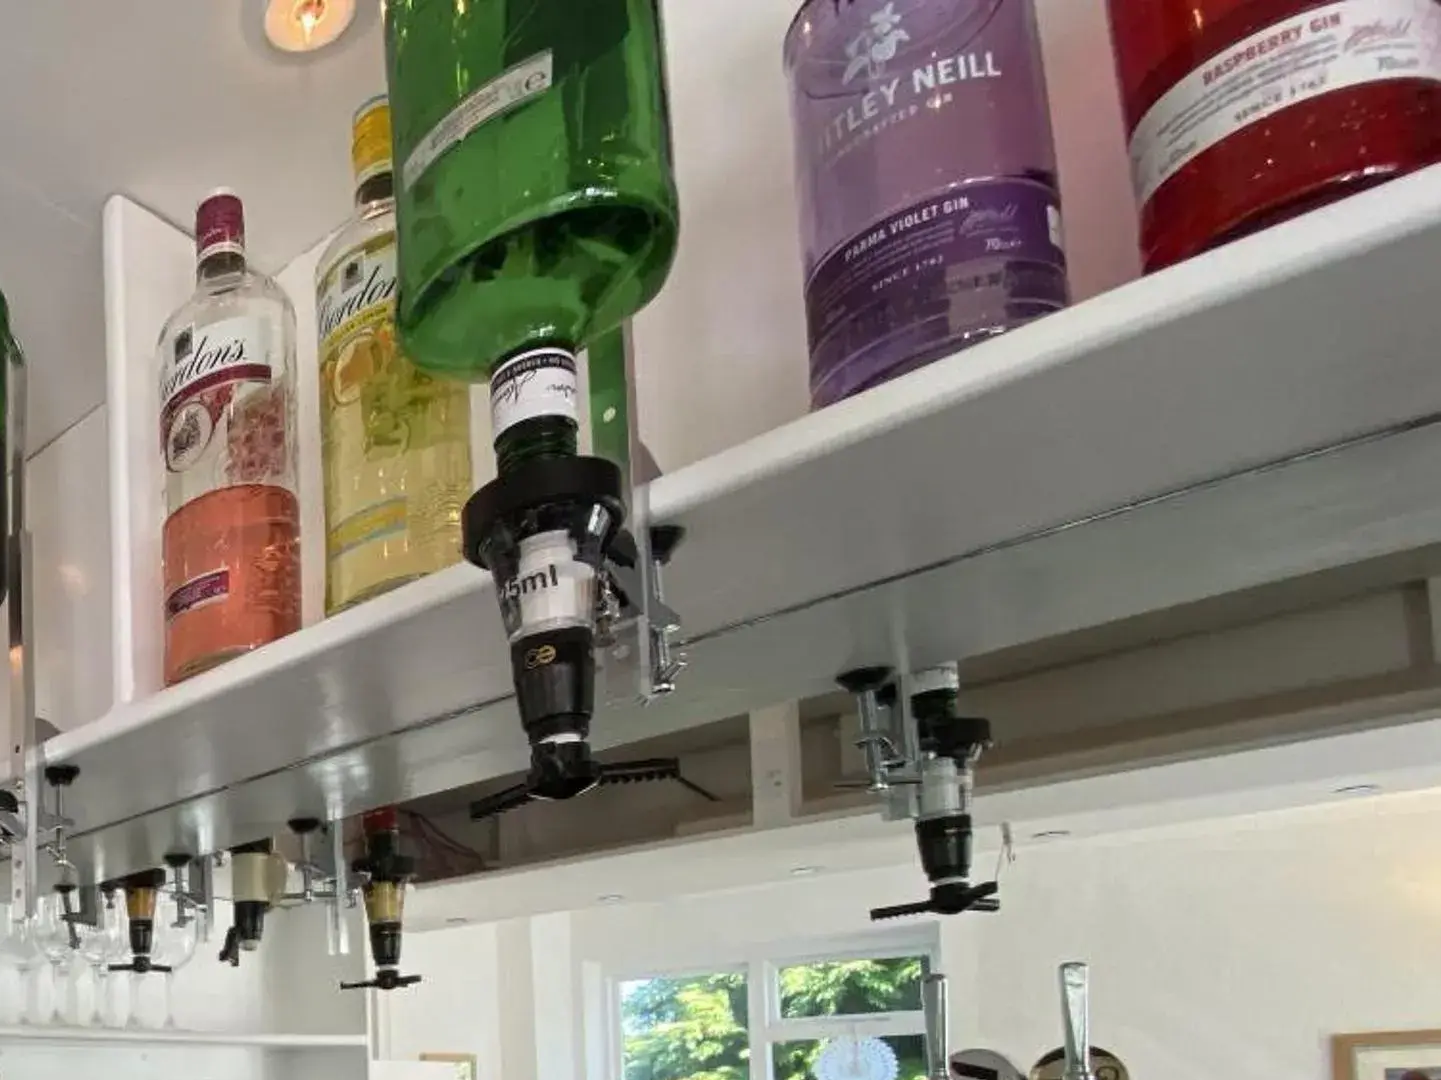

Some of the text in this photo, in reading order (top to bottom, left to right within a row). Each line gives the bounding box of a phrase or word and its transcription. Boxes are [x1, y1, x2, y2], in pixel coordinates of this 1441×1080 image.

[912, 52, 1002, 93] NEILL
[1203, 26, 1303, 87] RASPBERRY
[1310, 12, 1341, 33] GIN
[844, 230, 887, 263] PARMA
[889, 207, 940, 236] VIOLET
[943, 196, 970, 214] GIN
